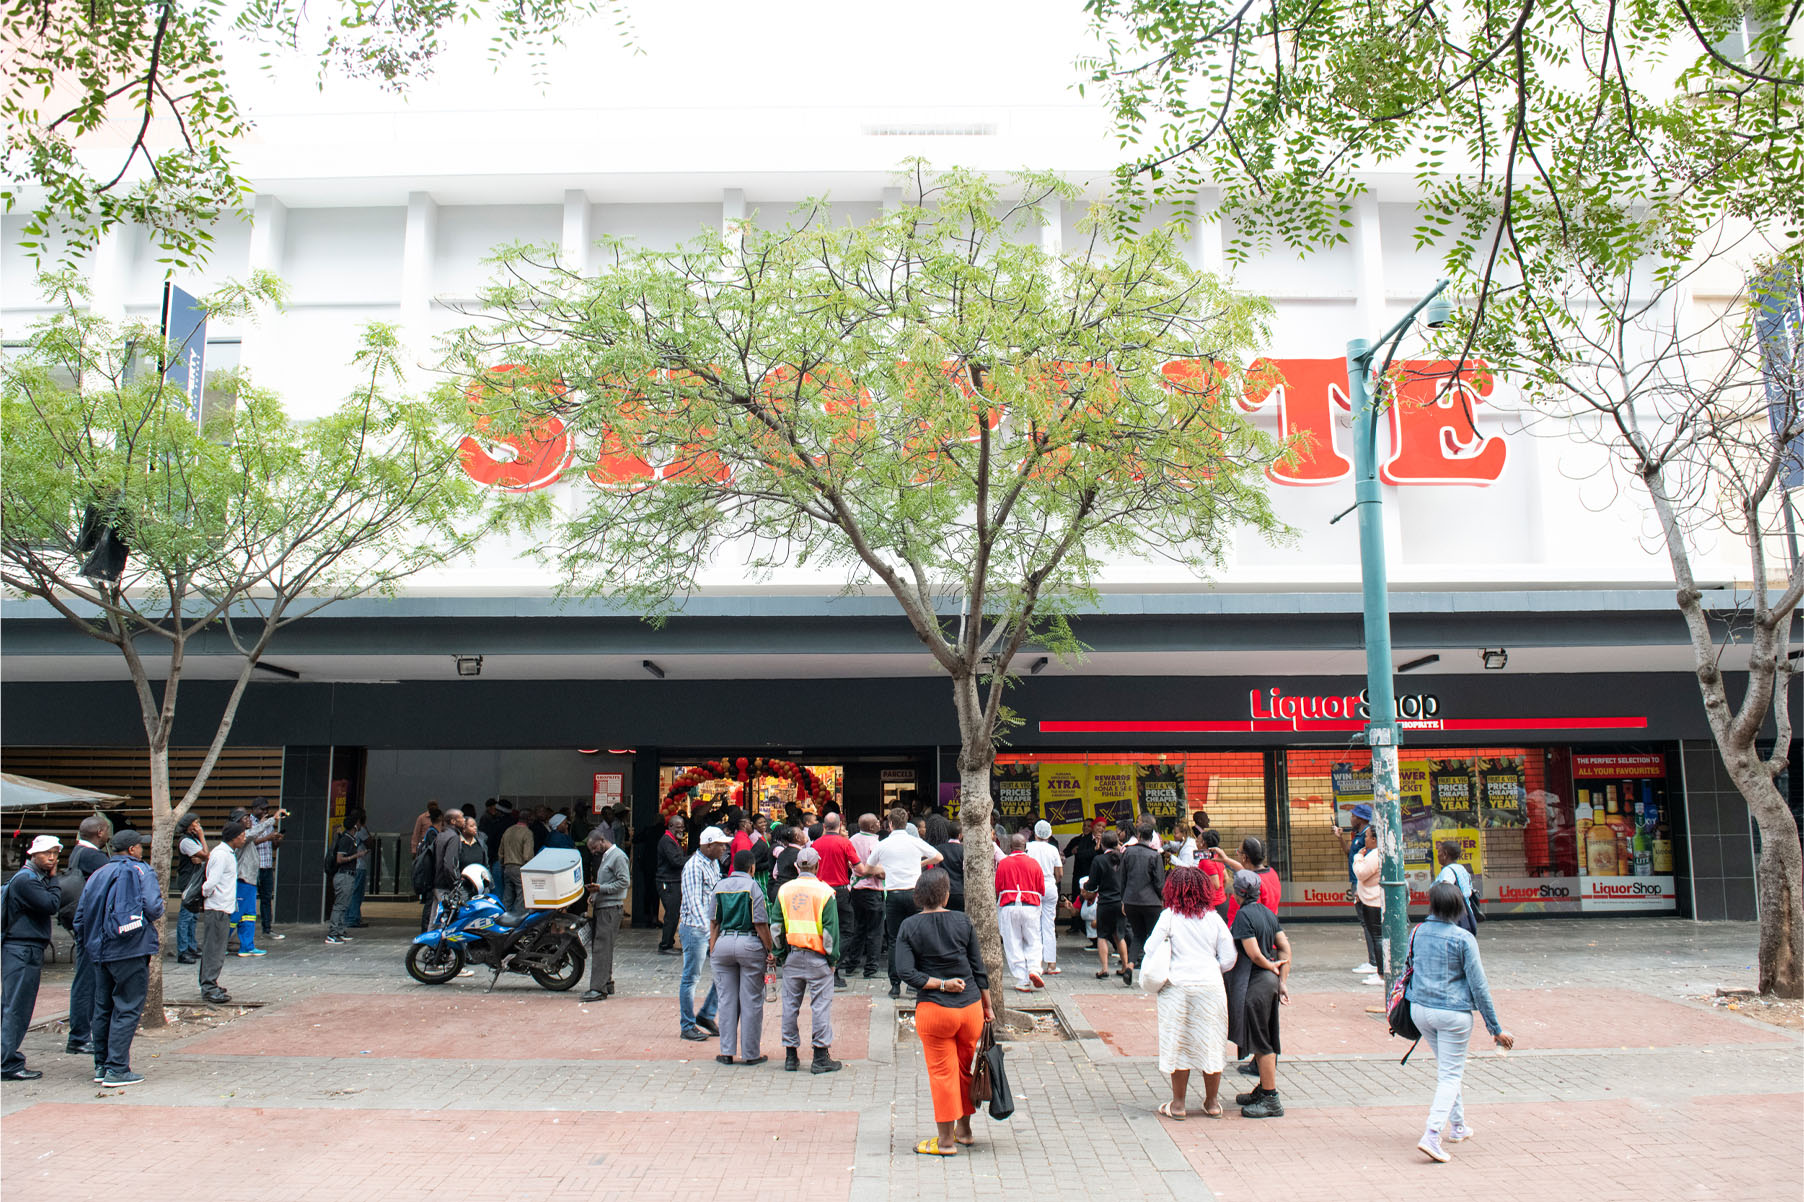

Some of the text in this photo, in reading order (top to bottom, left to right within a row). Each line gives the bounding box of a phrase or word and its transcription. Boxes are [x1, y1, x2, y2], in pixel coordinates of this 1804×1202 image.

[1250, 688, 1440, 731] Liquorop
[1396, 720, 1439, 729] HOPRITE
[1594, 767, 1614, 775] YOUR
[1615, 767, 1660, 775] FAVOURITES
[1047, 780, 1081, 789] XTRA
[1145, 789, 1176, 797] PRICES
[1440, 801, 1469, 810] YEAR
[1489, 800, 1518, 809] YEAR
[1001, 807, 1031, 816] YEAR
[1147, 807, 1176, 816] YEAR
[1499, 885, 1570, 898] LiquorShop
[1592, 882, 1662, 896] LiquorShop
[1304, 889, 1356, 903] LiquorS
[119, 919, 143, 934] PUMA
